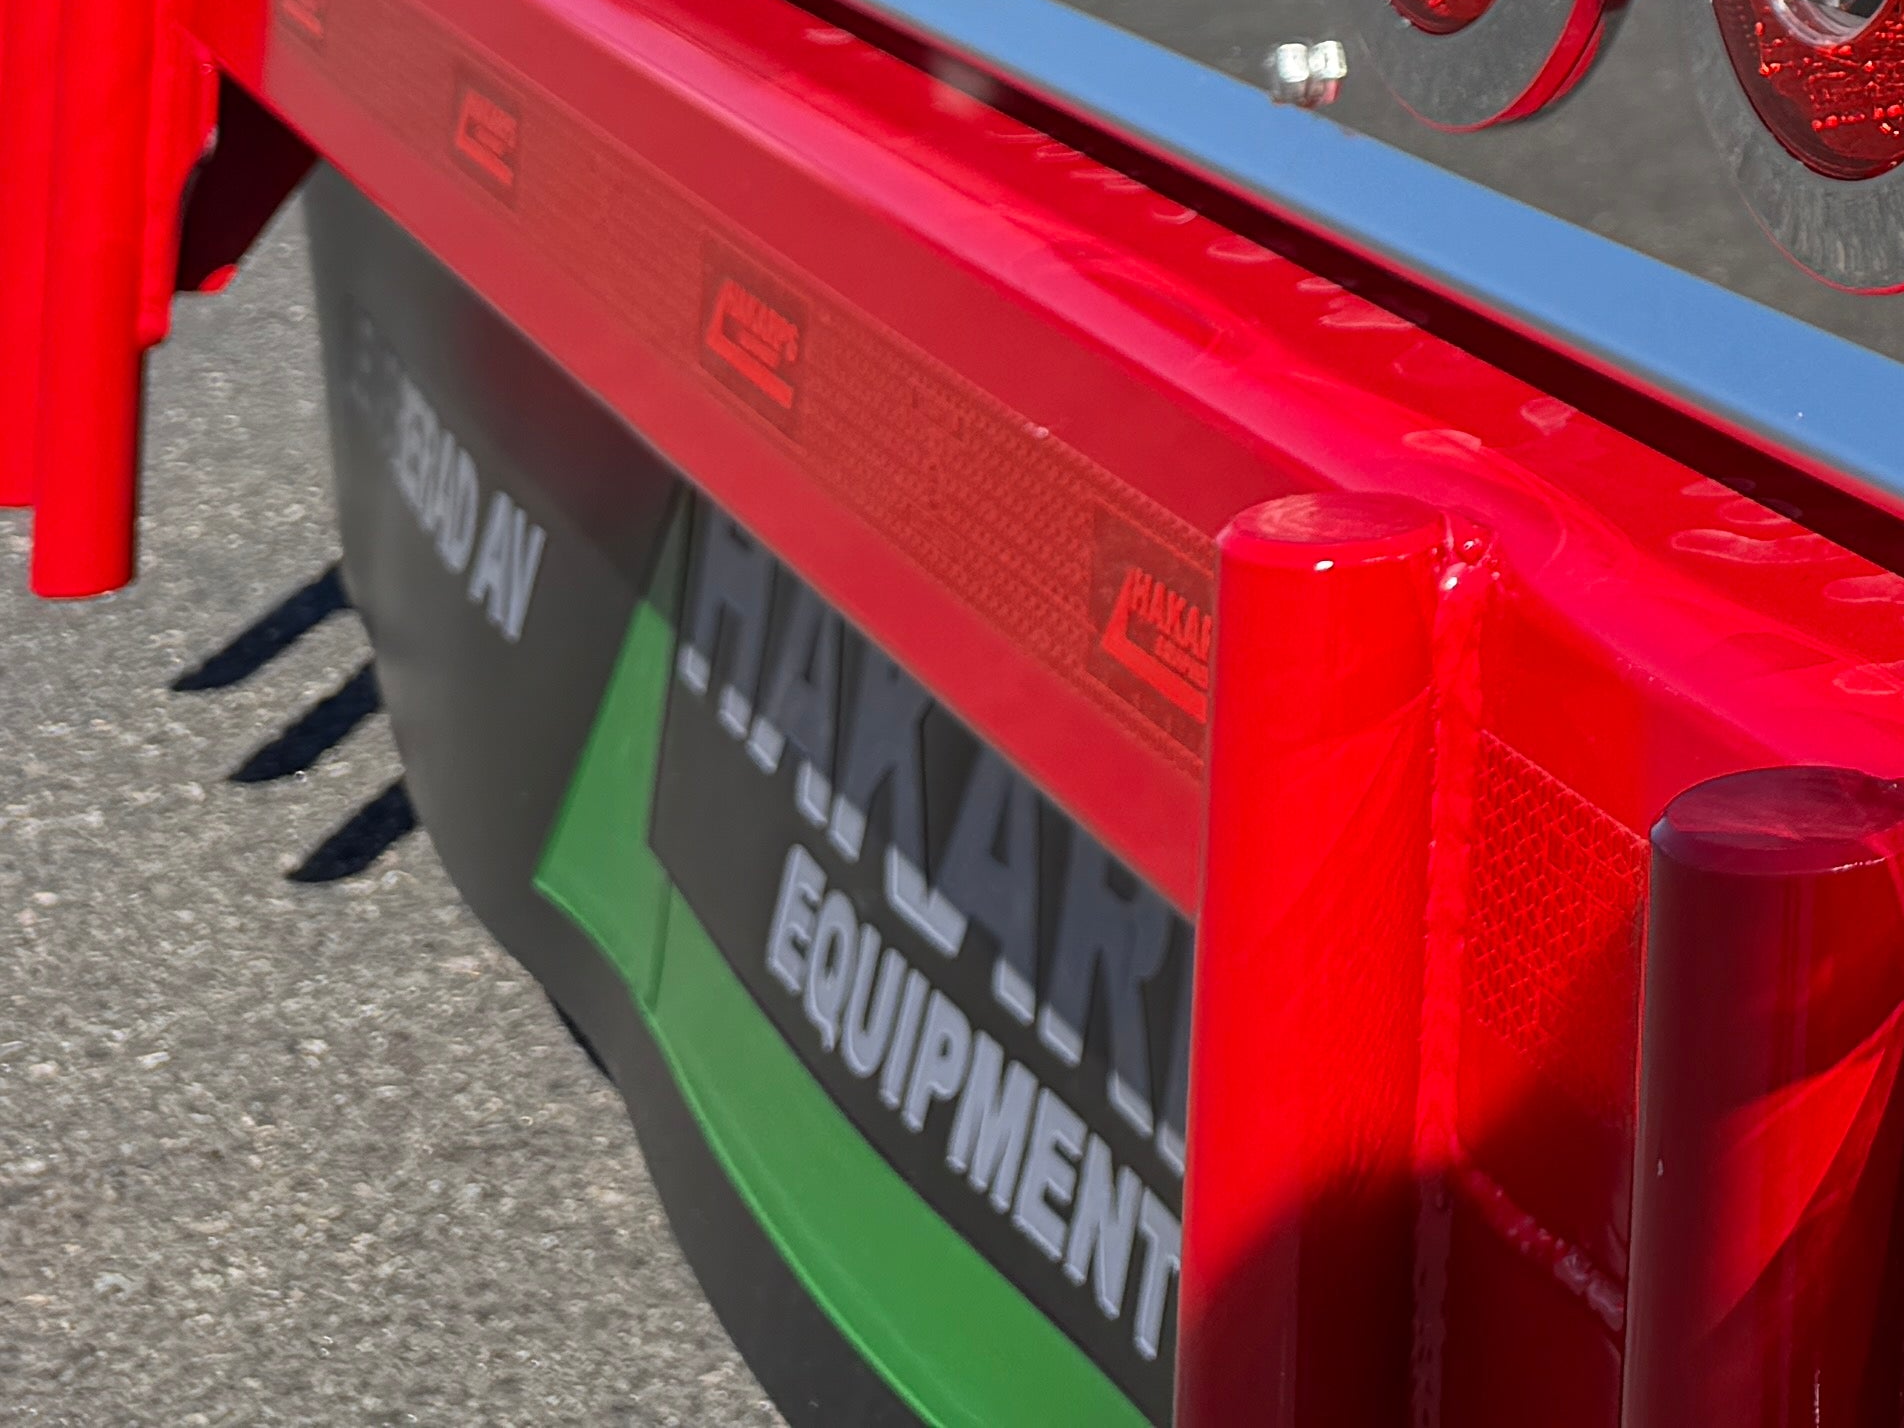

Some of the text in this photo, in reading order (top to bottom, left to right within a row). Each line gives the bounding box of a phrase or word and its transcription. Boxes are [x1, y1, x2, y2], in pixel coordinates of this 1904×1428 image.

[466, 489, 547, 646] AV
[677, 494, 1192, 1168] HAKAR
[766, 843, 1182, 1361] EQUIPMENT
